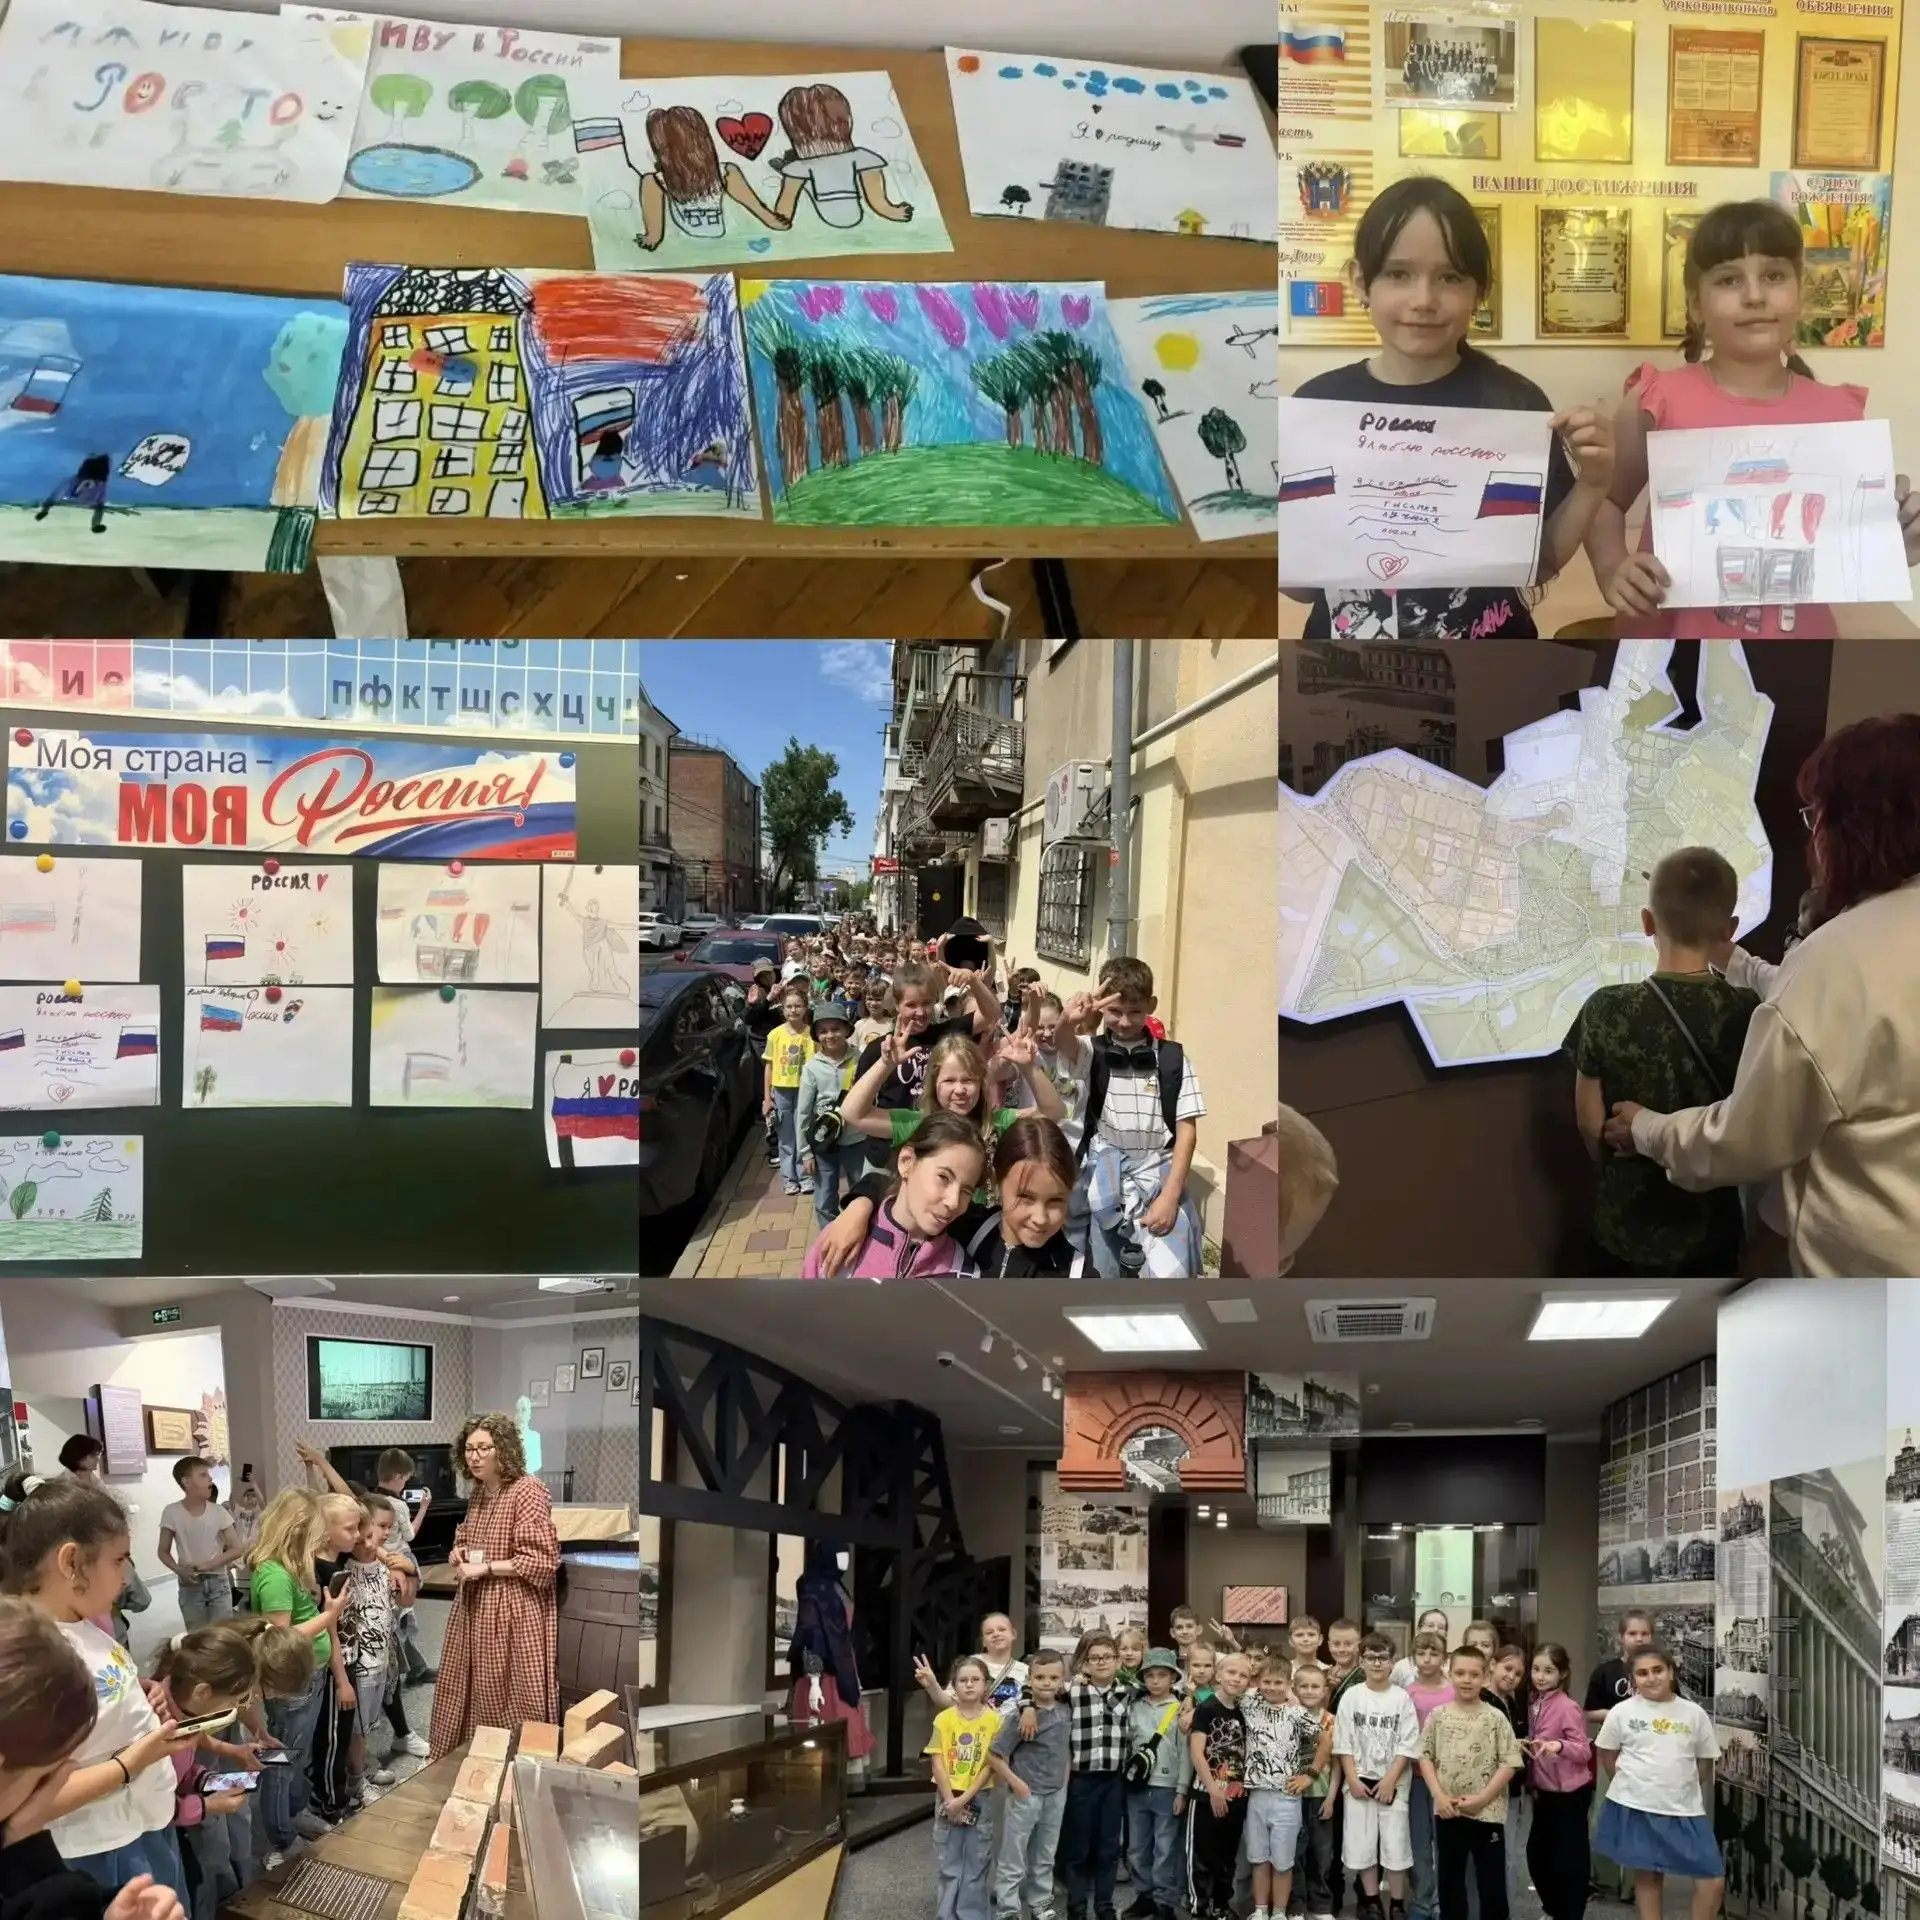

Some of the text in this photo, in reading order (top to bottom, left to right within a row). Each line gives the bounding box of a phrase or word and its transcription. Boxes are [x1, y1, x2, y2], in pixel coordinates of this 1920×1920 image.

[1472, 175, 1698, 197] НАШИ ДОСТИЖЕНИЯ
[37, 738, 112, 771] Моя
[125, 748, 247, 779] страна
[118, 746, 547, 847] МОЯ Россия!
